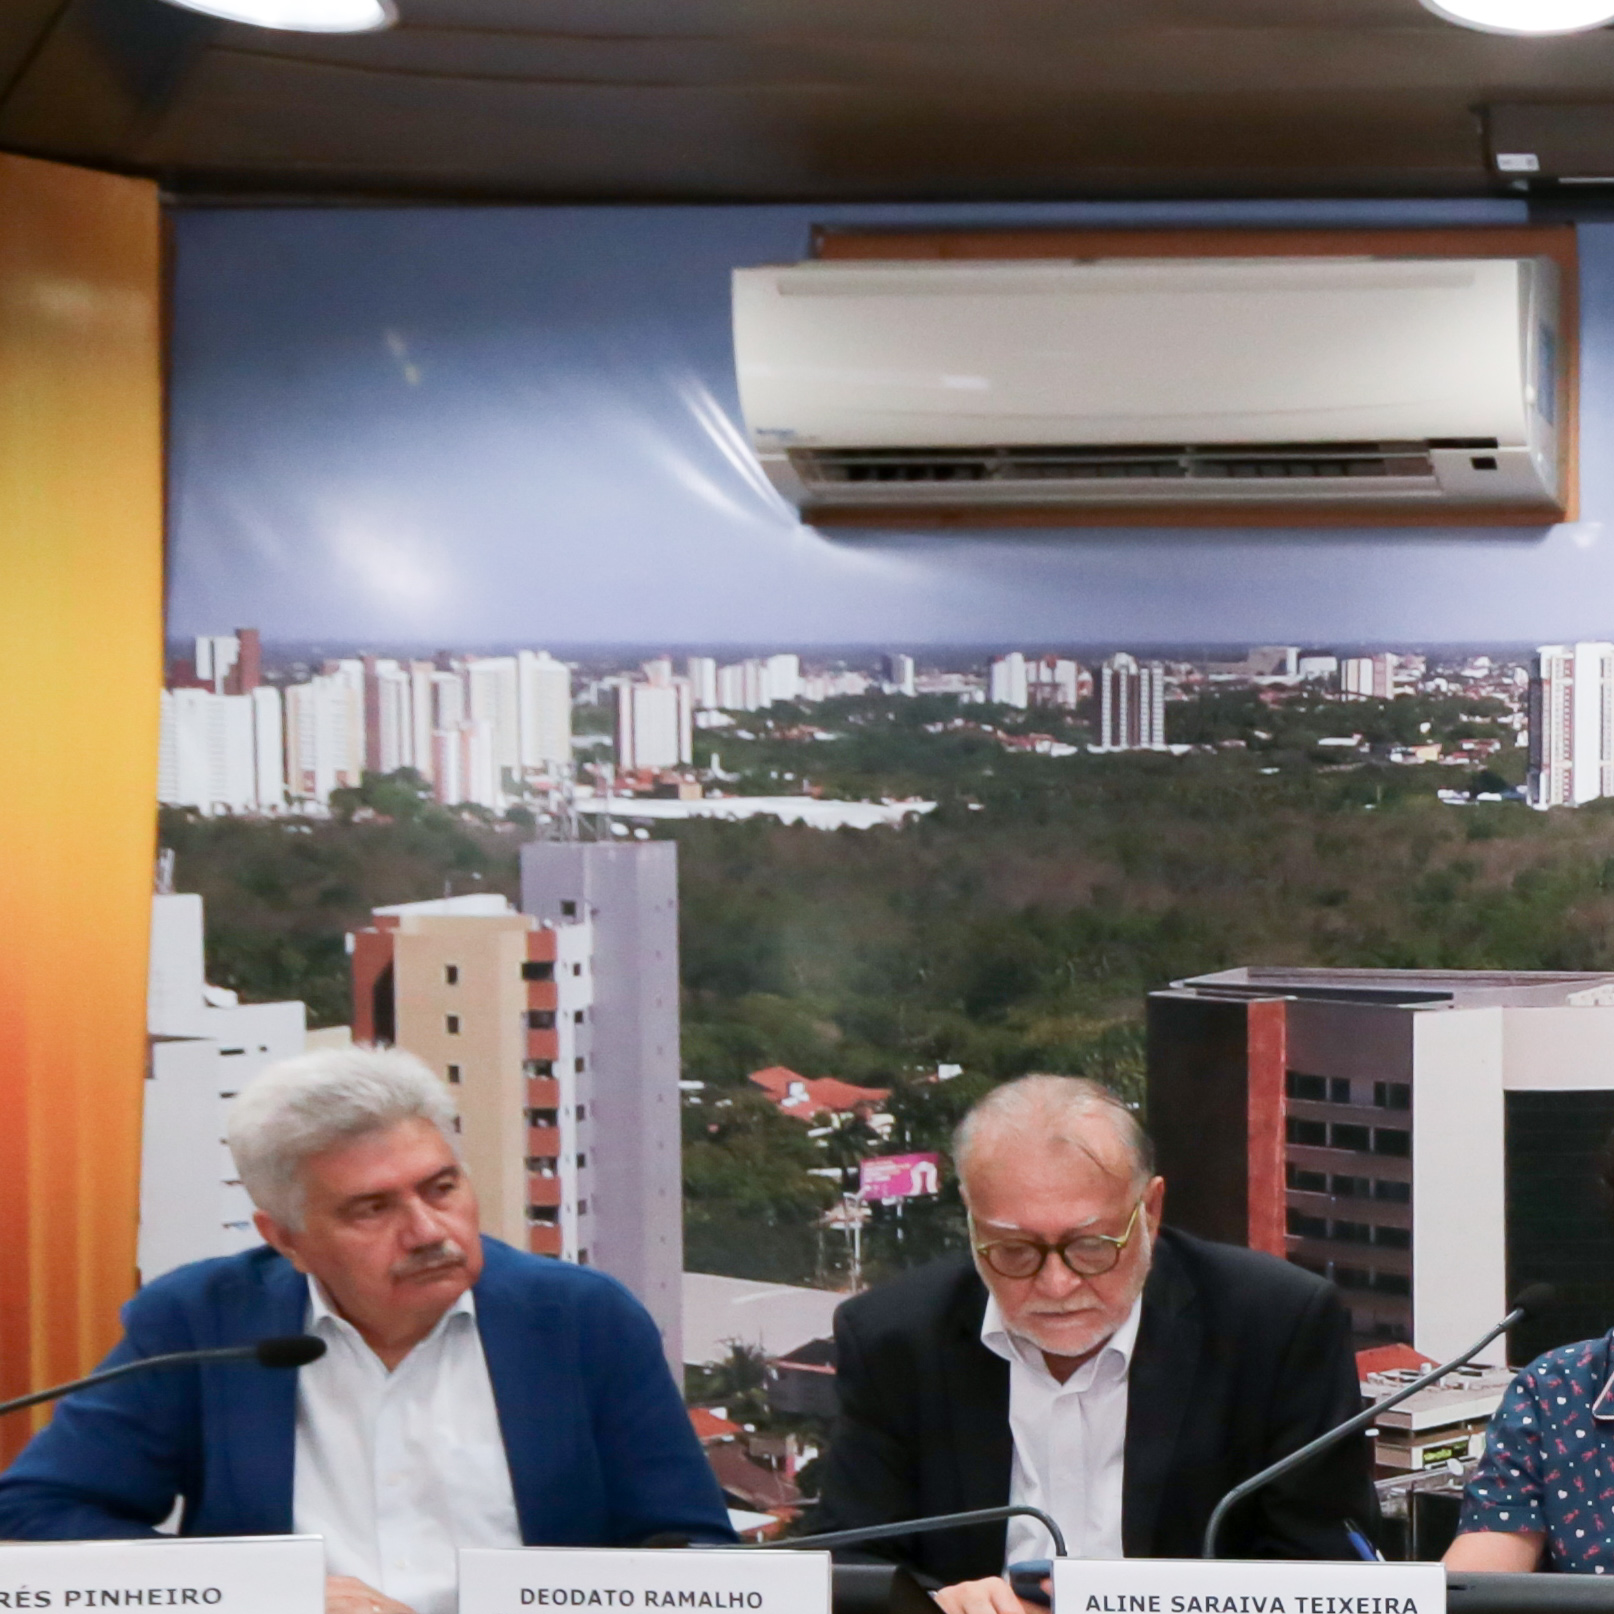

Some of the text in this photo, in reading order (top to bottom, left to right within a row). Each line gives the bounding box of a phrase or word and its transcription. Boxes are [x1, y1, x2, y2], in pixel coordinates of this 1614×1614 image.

[64, 1587, 223, 1607] PINHEIRO
[520, 1587, 763, 1610] DEODATO RAMALHO
[1085, 1594, 1418, 1614] ALINE SARAIVA TEIXEIRA
